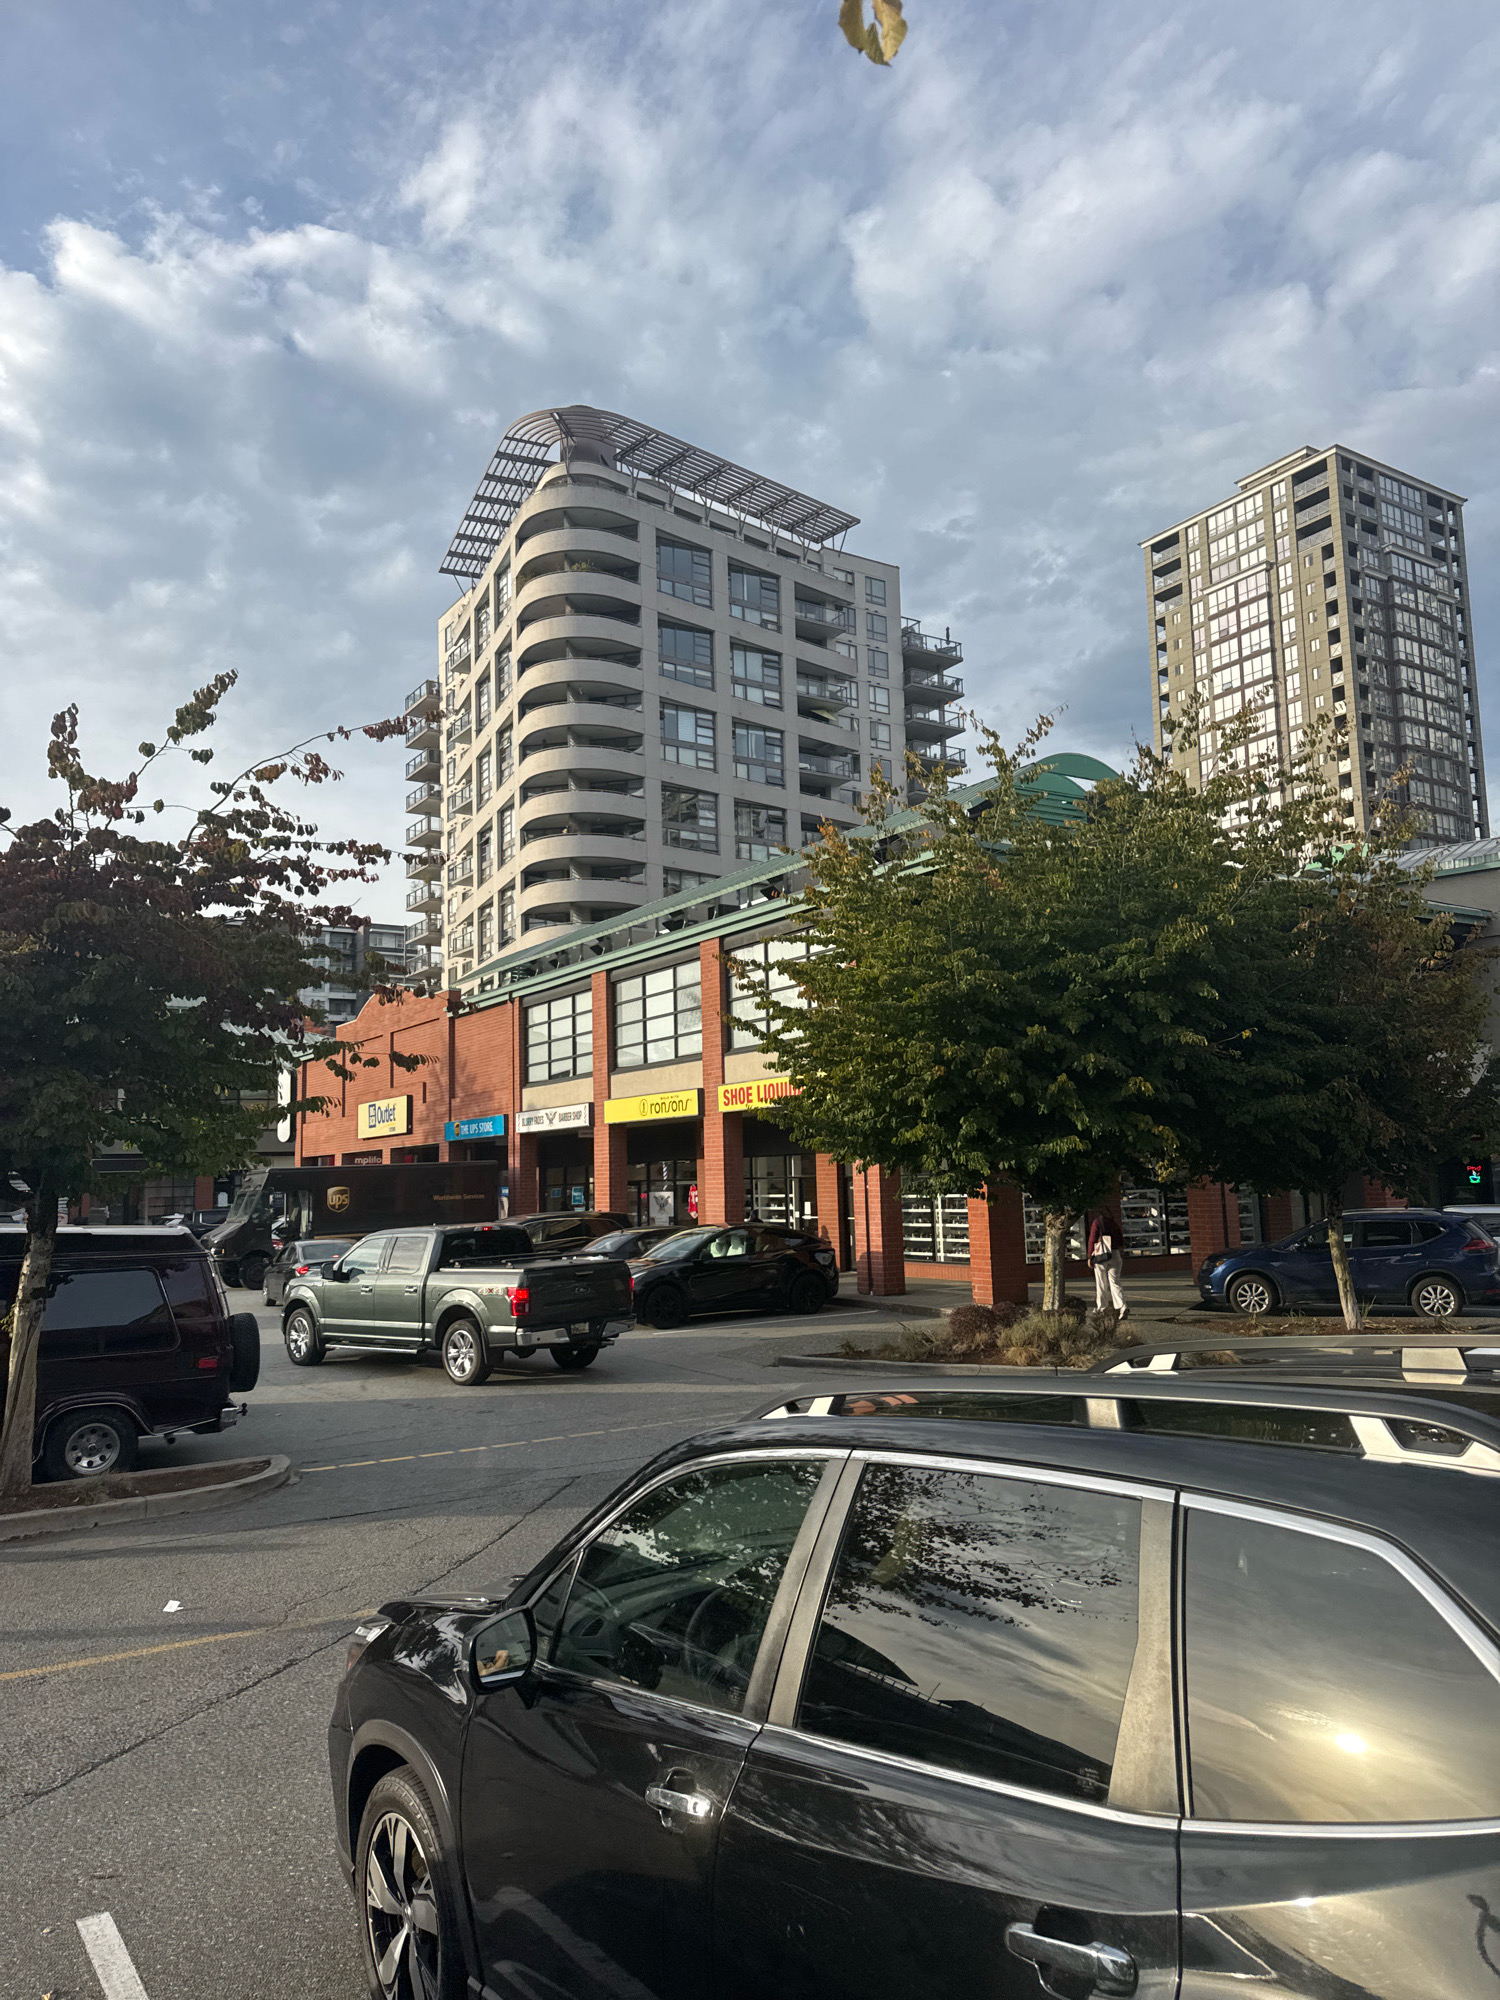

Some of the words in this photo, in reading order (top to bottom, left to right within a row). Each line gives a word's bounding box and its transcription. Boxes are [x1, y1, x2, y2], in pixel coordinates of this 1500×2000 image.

[723, 1086, 753, 1106] SHOE
[377, 1103, 396, 1124] Outlet
[650, 1099, 689, 1114] ronsons
[573, 1110, 582, 1121] SHOP
[461, 1124, 469, 1135] THE
[470, 1122, 479, 1134] UPS
[479, 1121, 493, 1133] STORE
[354, 1155, 382, 1165] mplifo
[329, 1194, 349, 1209] ups
